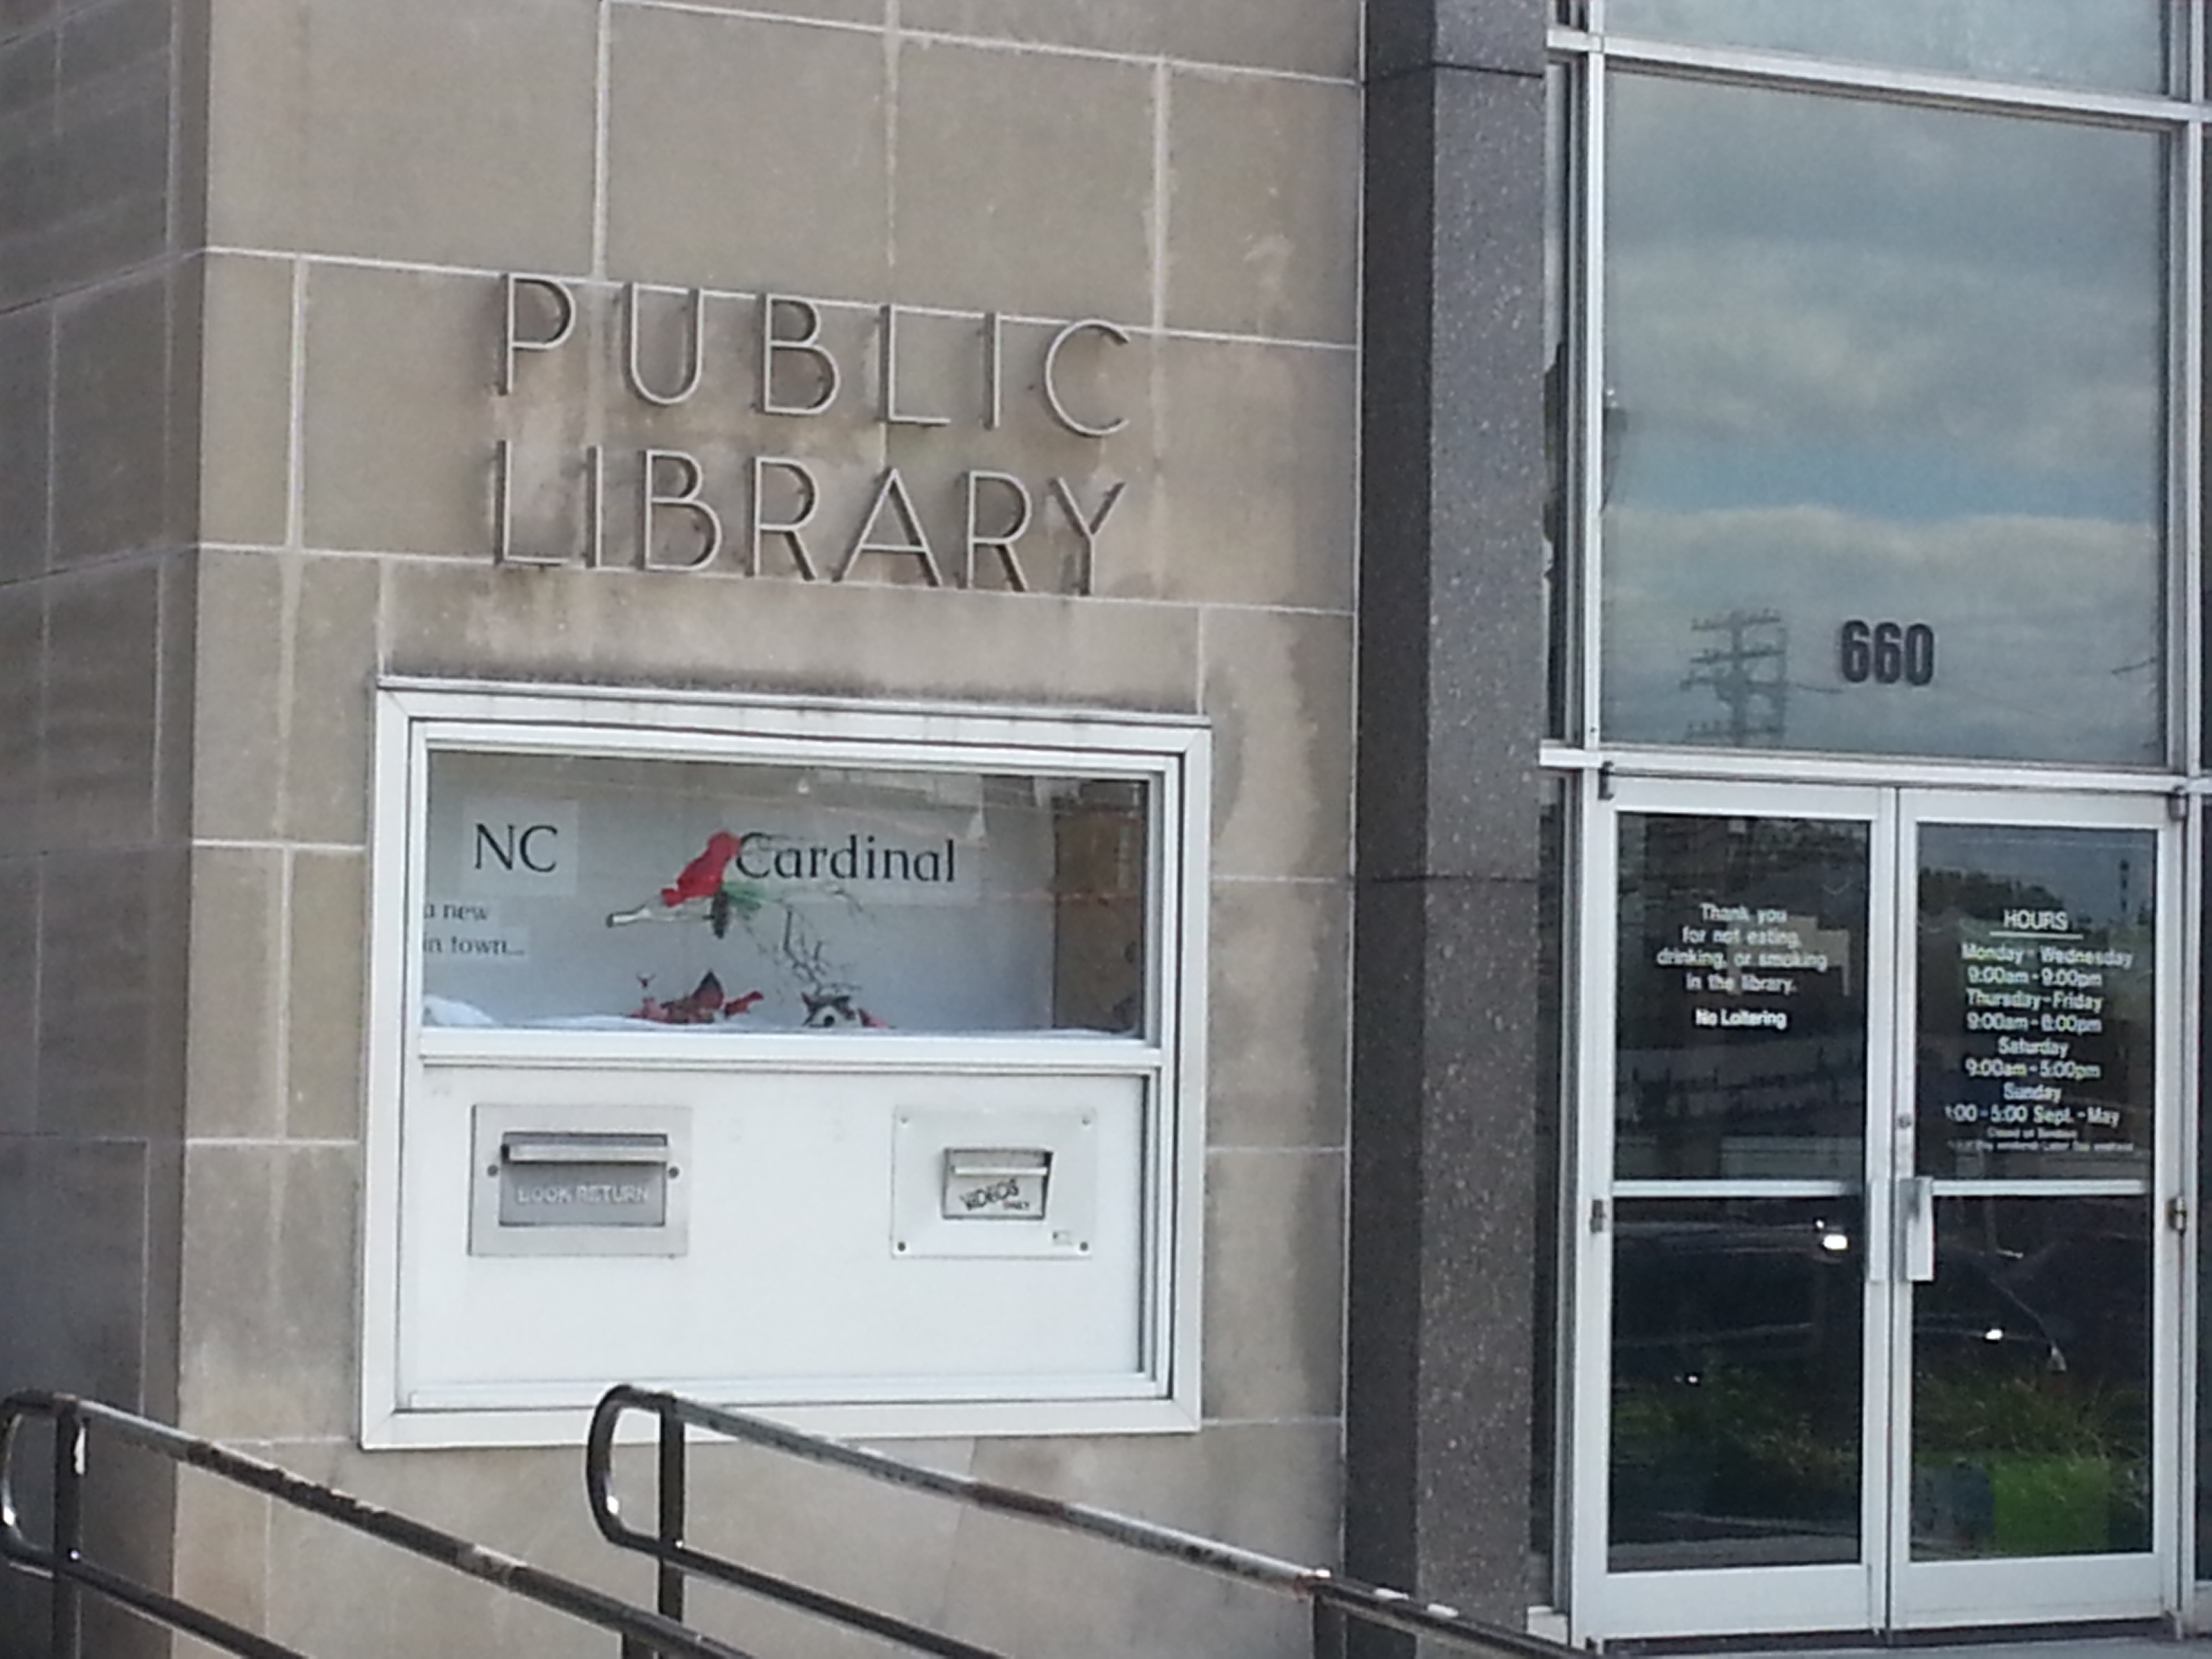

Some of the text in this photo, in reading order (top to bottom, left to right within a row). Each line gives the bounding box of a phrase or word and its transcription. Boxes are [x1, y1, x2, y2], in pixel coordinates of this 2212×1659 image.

[497, 271, 1131, 438] PUBLIC
[493, 439, 1128, 595] LIBRARY
[1841, 619, 1935, 687] 660
[474, 823, 956, 882] NC Cardinal
[443, 903, 487, 920] new
[1700, 902, 1788, 925] Thank you
[2003, 909, 2069, 930] HOURS
[1681, 926, 1706, 944] for
[1713, 927, 1741, 945] not
[1656, 947, 1828, 972] drinking, or smoking
[1961, 943, 2025, 964] Monday
[2040, 945, 2133, 968] Wednesday
[1707, 973, 1735, 991] the
[1967, 966, 2029, 985] 9:00am
[2041, 967, 2103, 988] 9:00pm
[1695, 1008, 1788, 1030] No Loitering
[1967, 1012, 2029, 1031] 9:00am
[1997, 1036, 2070, 1059] Saturday
[1965, 1058, 2028, 1077] 9:00am
[2003, 1082, 2062, 1104] Sunday
[2087, 1106, 2121, 1128] May
[575, 1183, 649, 1205] RETURN
[959, 1178, 1019, 1210] VIDEOS
